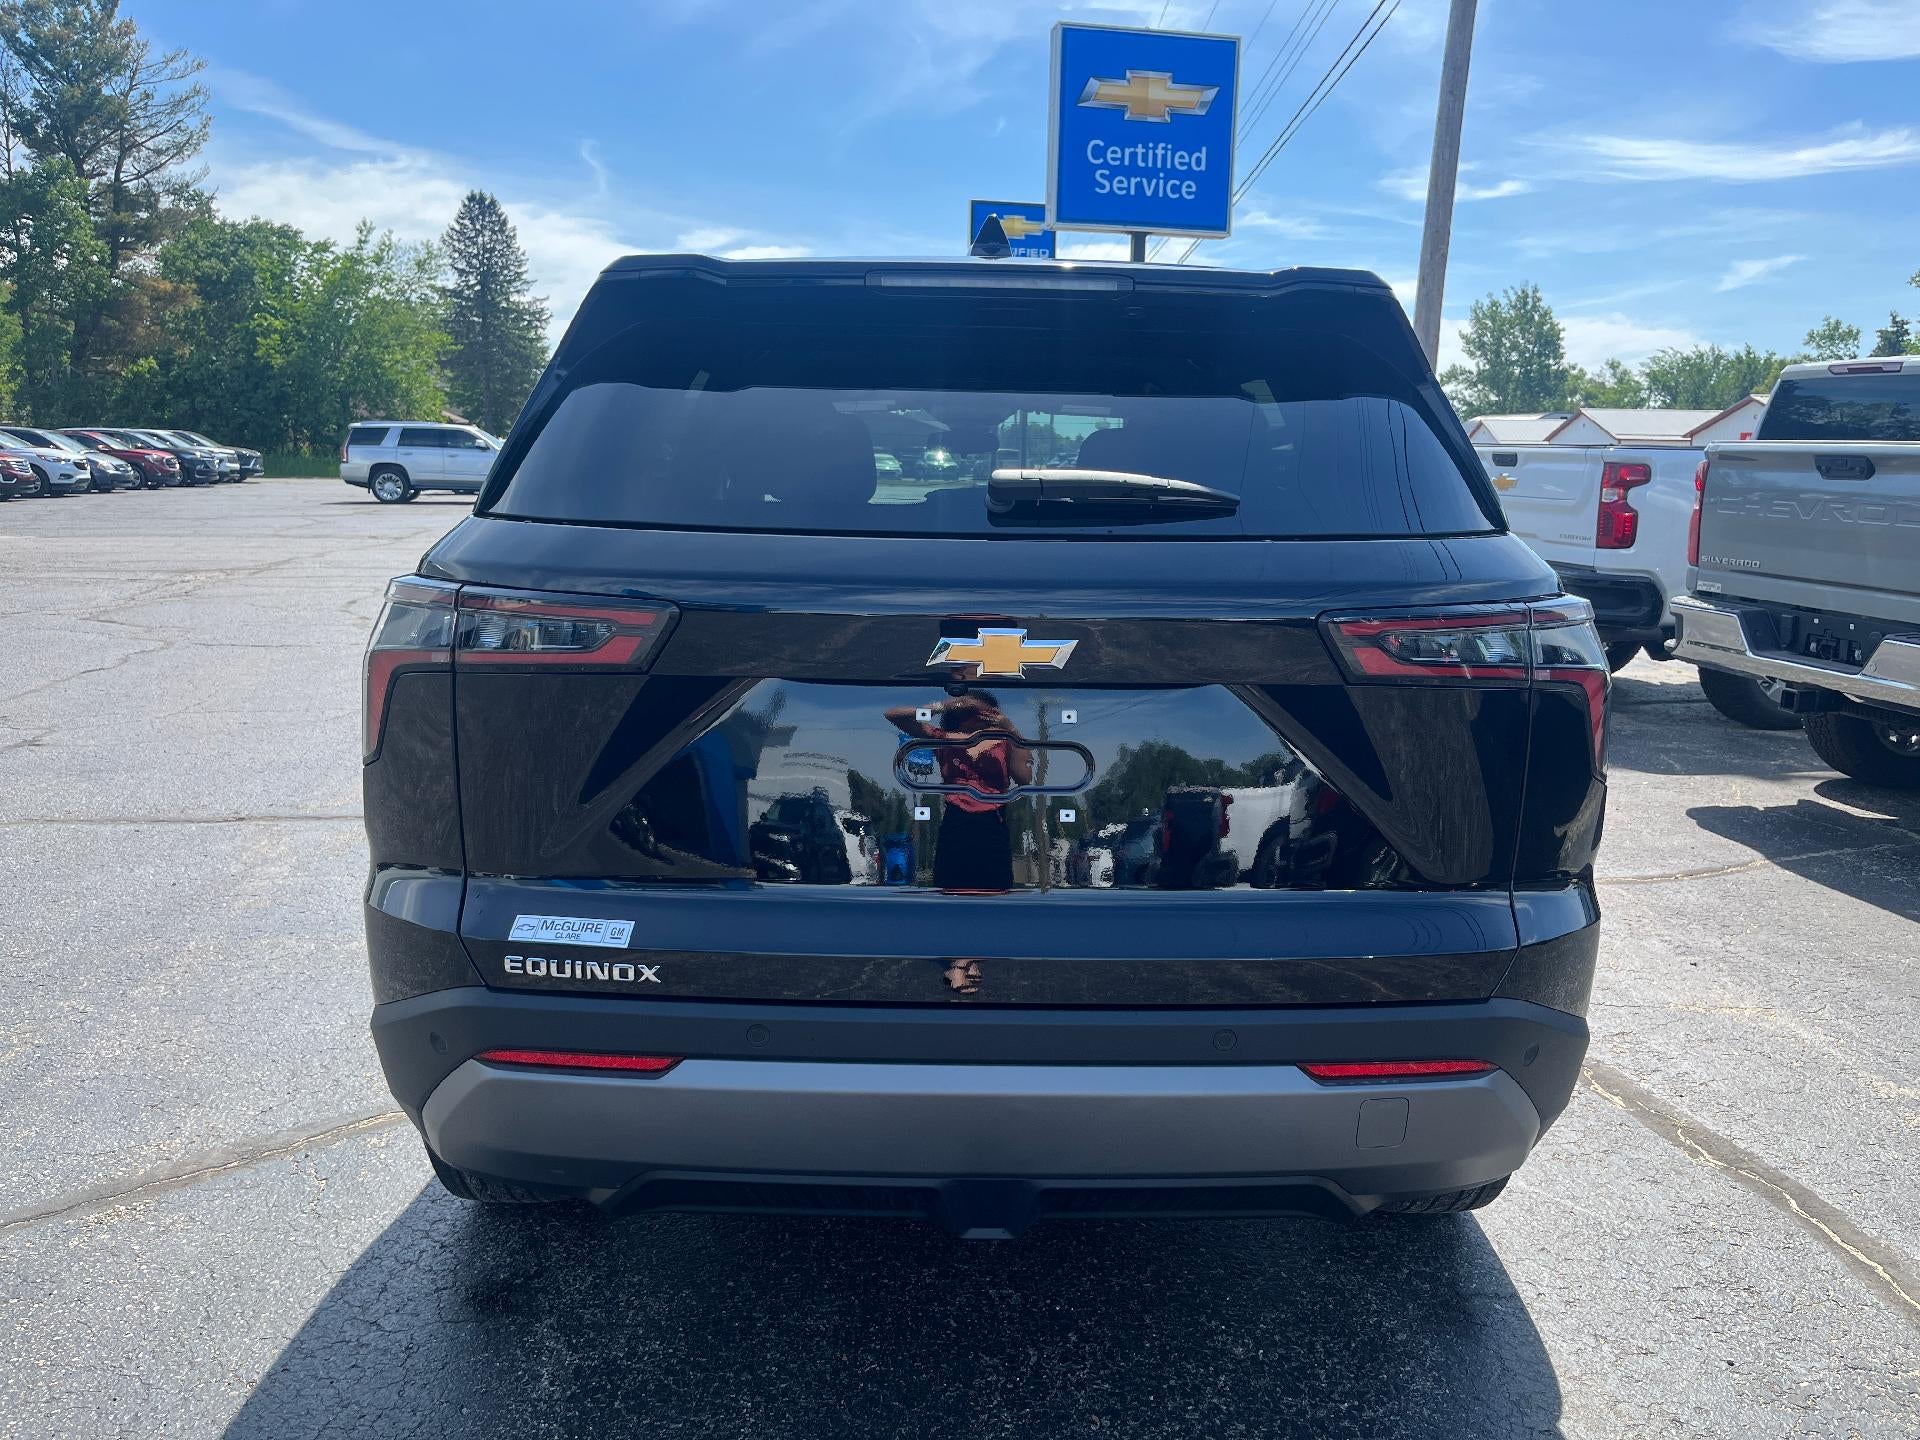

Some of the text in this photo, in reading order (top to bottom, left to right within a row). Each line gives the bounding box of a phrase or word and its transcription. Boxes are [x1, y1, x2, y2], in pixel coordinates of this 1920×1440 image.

[1086, 139, 1207, 171] Certified
[1094, 169, 1197, 200] Service
[1011, 247, 1050, 259] IFIED
[1701, 555, 1761, 568] SILVERADO
[540, 919, 604, 934] McGUIRE
[610, 926, 624, 937] GM
[554, 931, 581, 940] CLARE
[504, 955, 661, 983] EQUINOX
